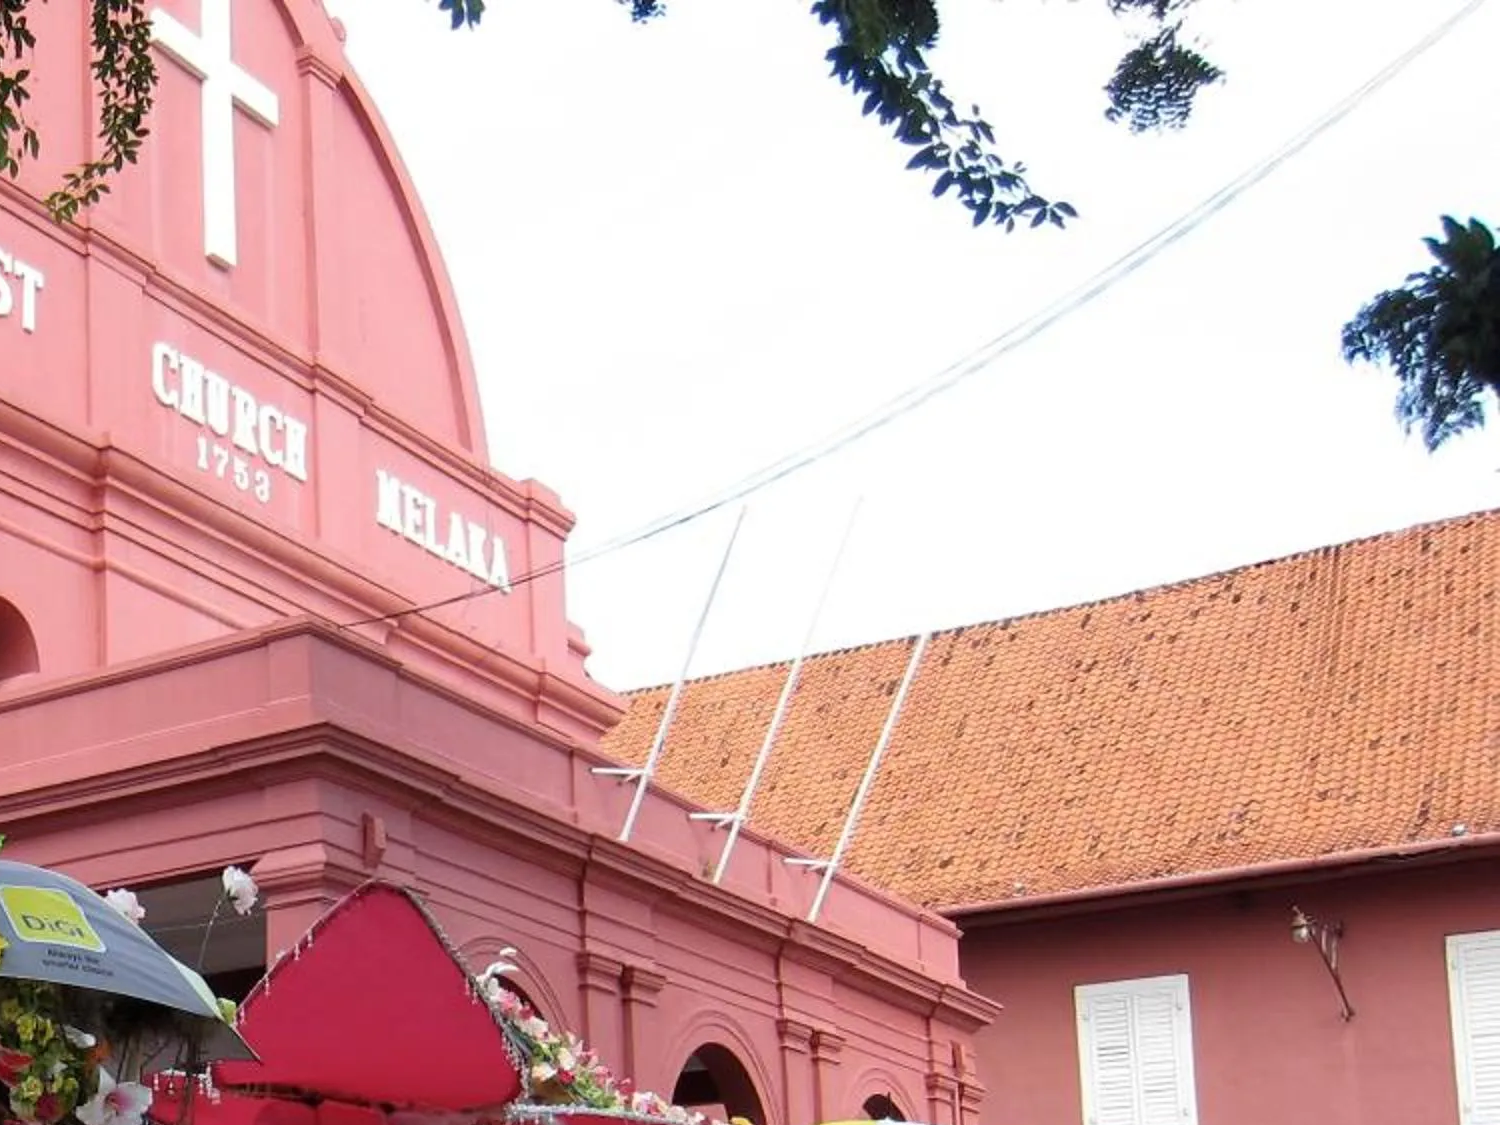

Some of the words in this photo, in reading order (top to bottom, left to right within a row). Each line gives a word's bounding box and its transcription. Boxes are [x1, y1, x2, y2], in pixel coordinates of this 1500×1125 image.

[152, 342, 308, 483] CHURCH
[196, 434, 270, 503] 1753
[376, 468, 513, 596] MELAKA
